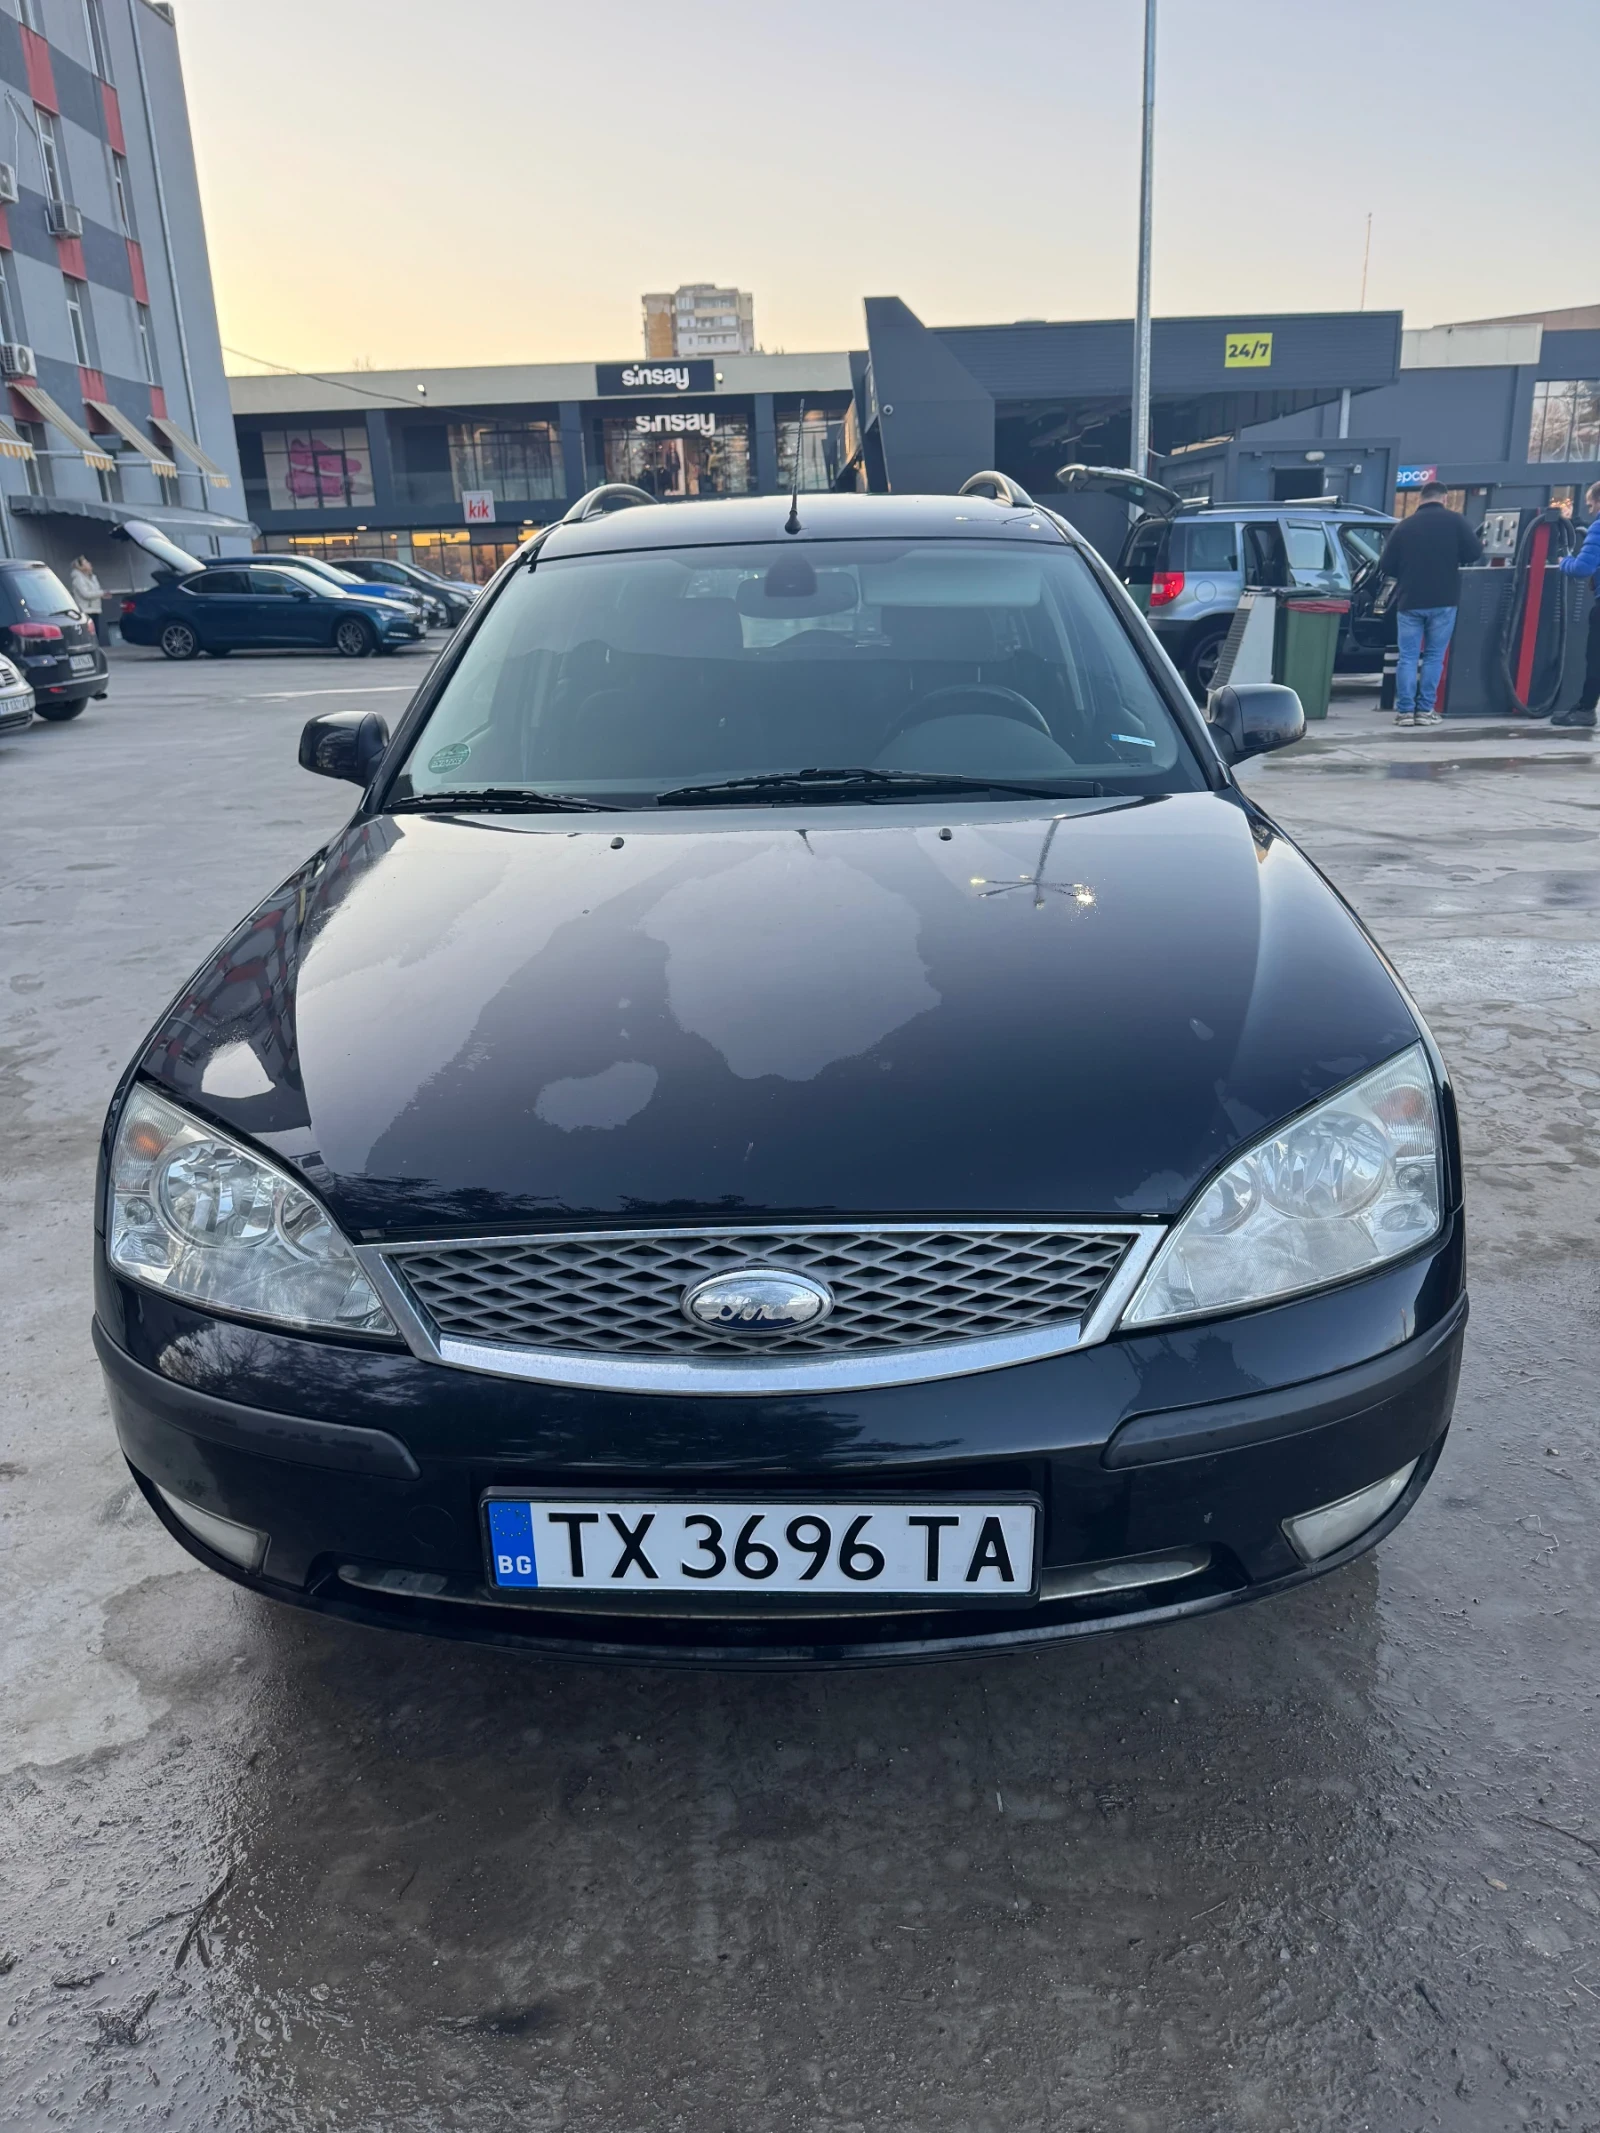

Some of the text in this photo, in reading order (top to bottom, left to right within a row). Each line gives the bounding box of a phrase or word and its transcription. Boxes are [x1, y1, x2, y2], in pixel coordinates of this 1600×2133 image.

[1228, 340, 1270, 360] 24/7
[621, 364, 690, 390] sinsay
[635, 412, 716, 437] sinsay
[548, 1512, 1015, 1582] TX 3696 TA
[497, 1555, 532, 1575] BG
